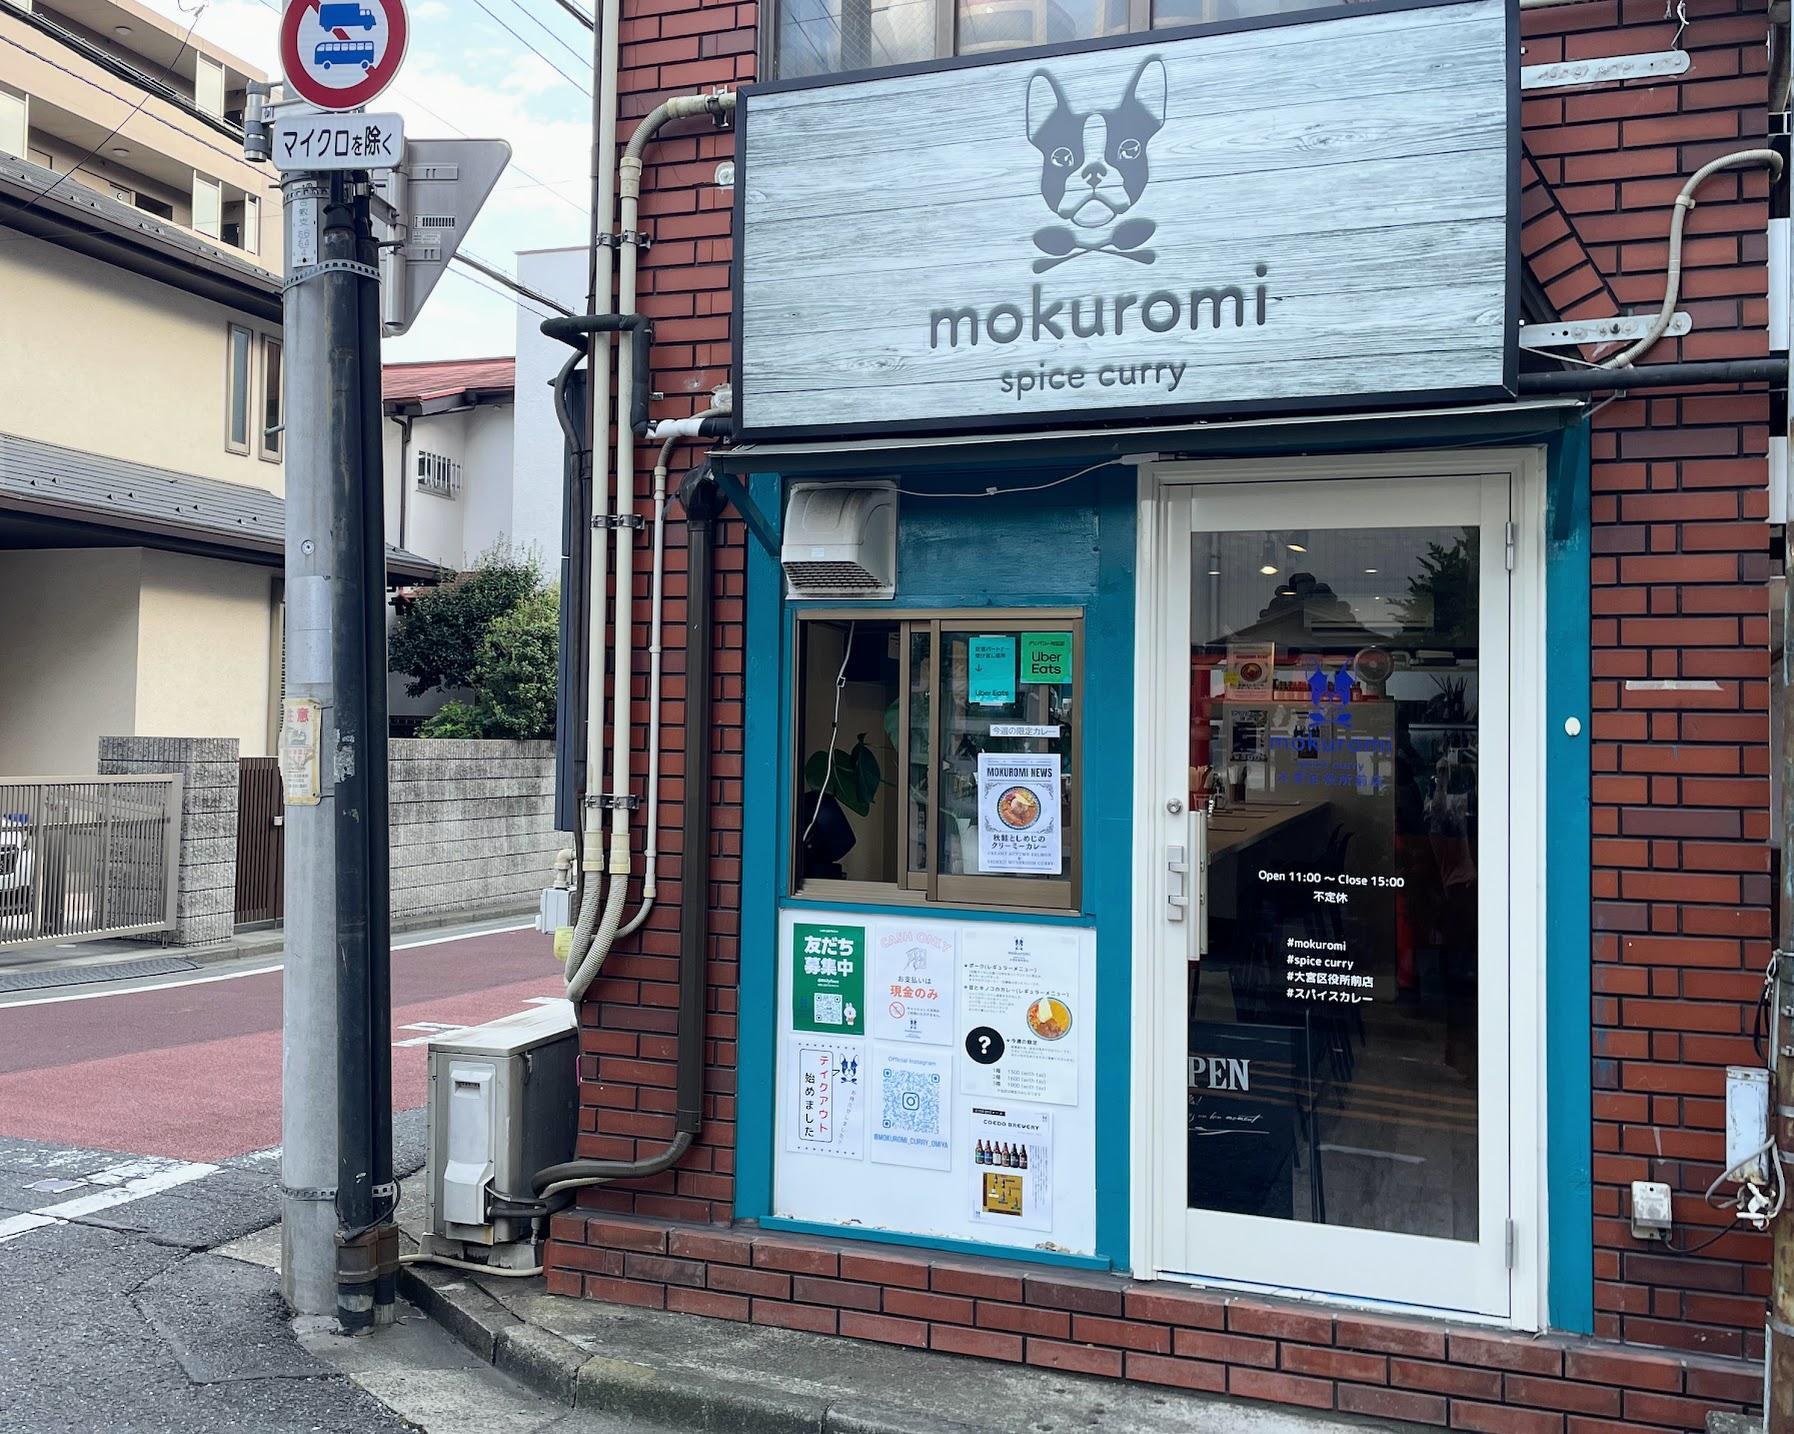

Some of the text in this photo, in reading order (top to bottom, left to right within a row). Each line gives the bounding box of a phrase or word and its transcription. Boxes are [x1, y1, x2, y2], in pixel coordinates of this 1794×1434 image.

[283, 125, 392, 158] マイクロを除く
[930, 264, 1267, 349] mokuromi
[1000, 361, 1187, 400] spice curry
[1031, 651, 1062, 662] Uber
[1031, 663, 1062, 675] Eats
[992, 726, 1056, 736] 今週の限定カレー
[1270, 731, 1392, 753] mokuromi
[987, 767, 1053, 778] MOKUROMI NEWS
[991, 842, 1047, 850] クリーミーカレー
[1258, 870, 1285, 882] Open
[1289, 872, 1321, 883] 11:00
[1338, 874, 1368, 886] Close
[1371, 876, 1405, 887] 15:00
[1313, 890, 1348, 904] 不定休
[804, 935, 854, 956] 友だち
[880, 930, 953, 953] CASH ONLY
[1286, 937, 1346, 951] #mokuromi
[804, 957, 854, 977] 募集中
[1286, 954, 1354, 970] #spice curry
[898, 975, 931, 985] お支払いは
[1286, 971, 1374, 988] #大宮区役所前店
[890, 985, 938, 1000] 現金のみ
[1286, 988, 1373, 1004] #スパイスカレー
[888, 1056, 937, 1066] Official Instagram
[1188, 1056, 1250, 1091] PEN
[819, 1055, 829, 1133] テイクアウト
[804, 1072, 816, 1137] 始めました
[983, 1119, 1040, 1131] COEDO BREWERY
[873, 1133, 948, 1149] @MOKUROMI_CURRY_OMIYA
